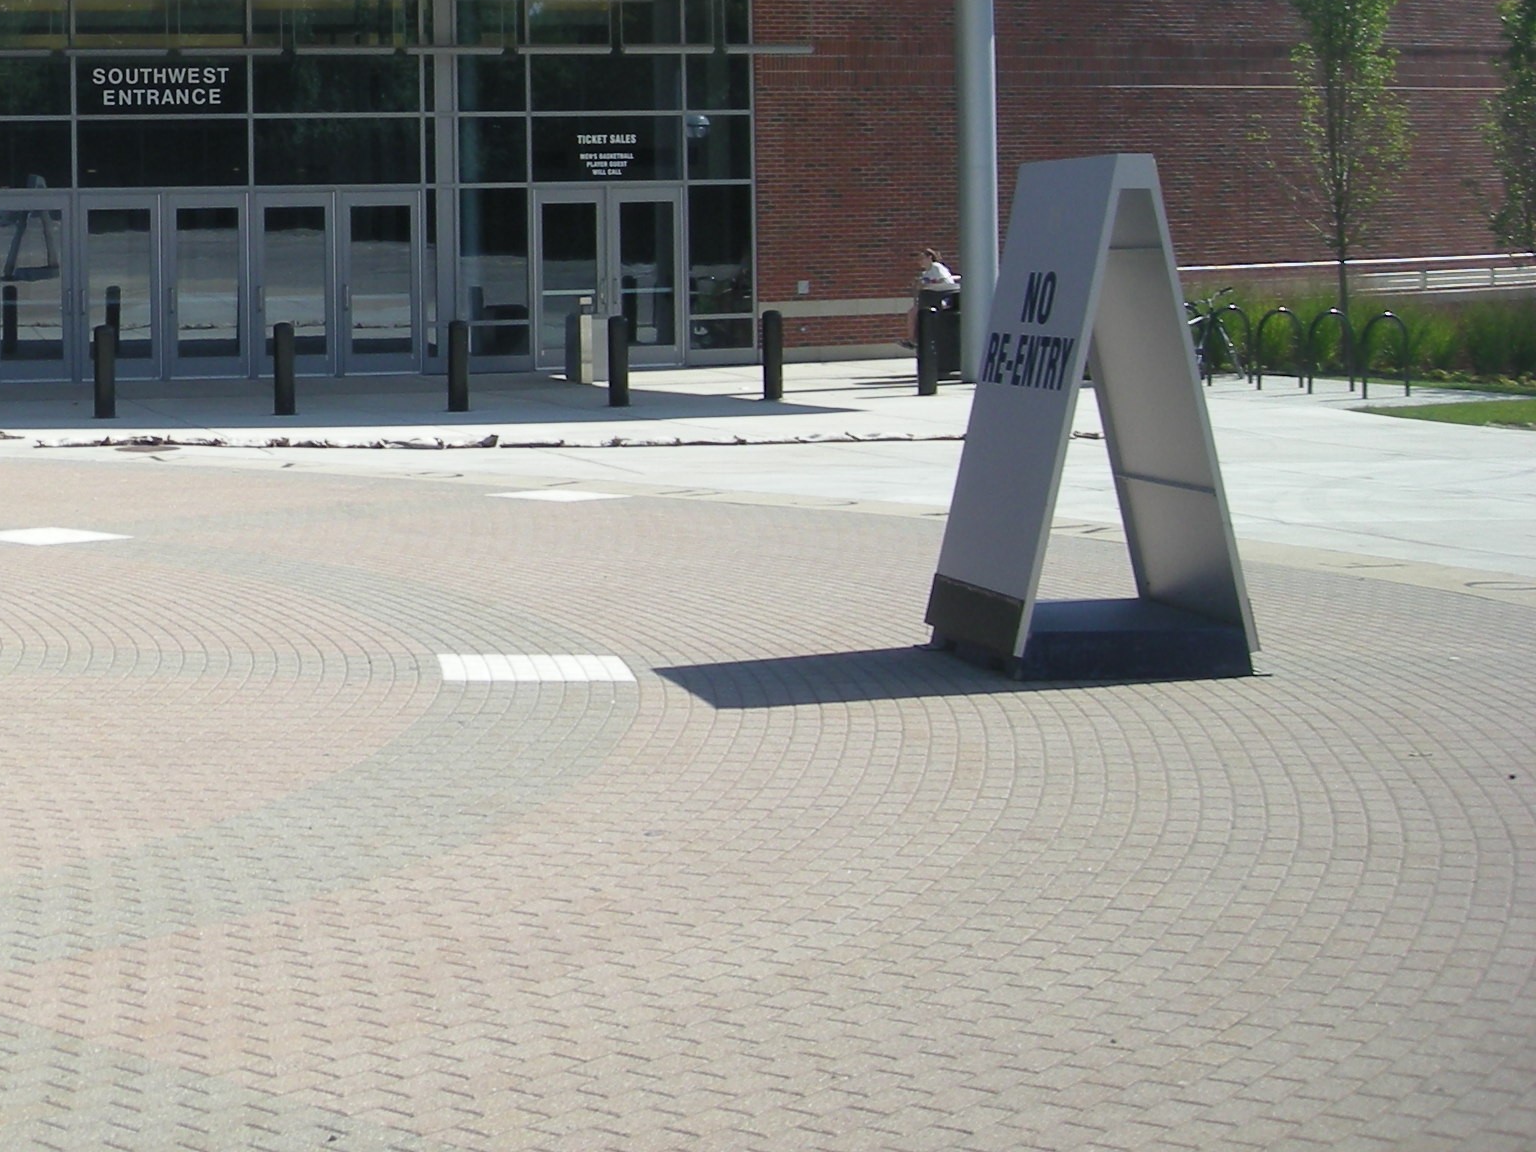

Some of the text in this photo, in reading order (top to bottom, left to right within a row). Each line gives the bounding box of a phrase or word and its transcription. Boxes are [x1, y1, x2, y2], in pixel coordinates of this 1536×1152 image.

[92, 67, 229, 85] SOUTHWEST
[102, 88, 221, 106] ENTRANCE
[577, 134, 637, 144] TICKET SALES
[592, 168, 622, 176] WILL CALL
[1020, 271, 1057, 325] NO
[982, 332, 1076, 391] RE-ENTRY
